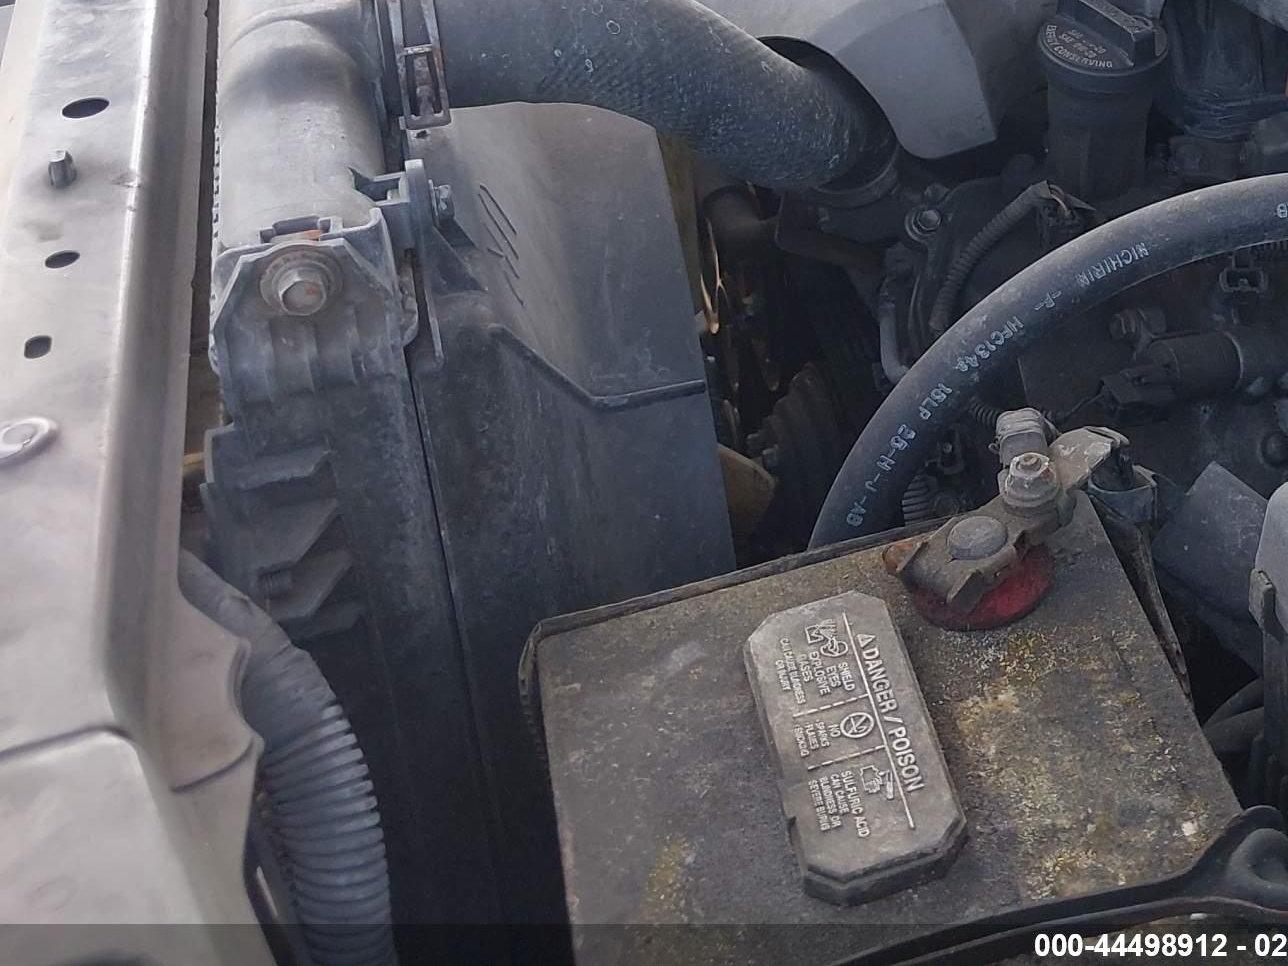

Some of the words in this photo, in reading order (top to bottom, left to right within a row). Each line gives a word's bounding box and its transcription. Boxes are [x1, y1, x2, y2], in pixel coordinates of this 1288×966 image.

[1075, 242, 1150, 287] NICHIRIN
[810, 651, 831, 696] EXPLOSIVE
[826, 665, 841, 688] EYES
[838, 662, 855, 691] SHIELD
[815, 721, 830, 747] SPARKS
[828, 724, 841, 738] NO
[862, 647, 898, 713] DANGER
[888, 726, 925, 793] POISON
[830, 774, 842, 789] CAN
[819, 776, 838, 814] BLINDNESS
[830, 816, 842, 828] OR
[835, 790, 850, 814] CAUSE
[841, 770, 864, 814] SULFURIC
[853, 816, 870, 837] ACID
